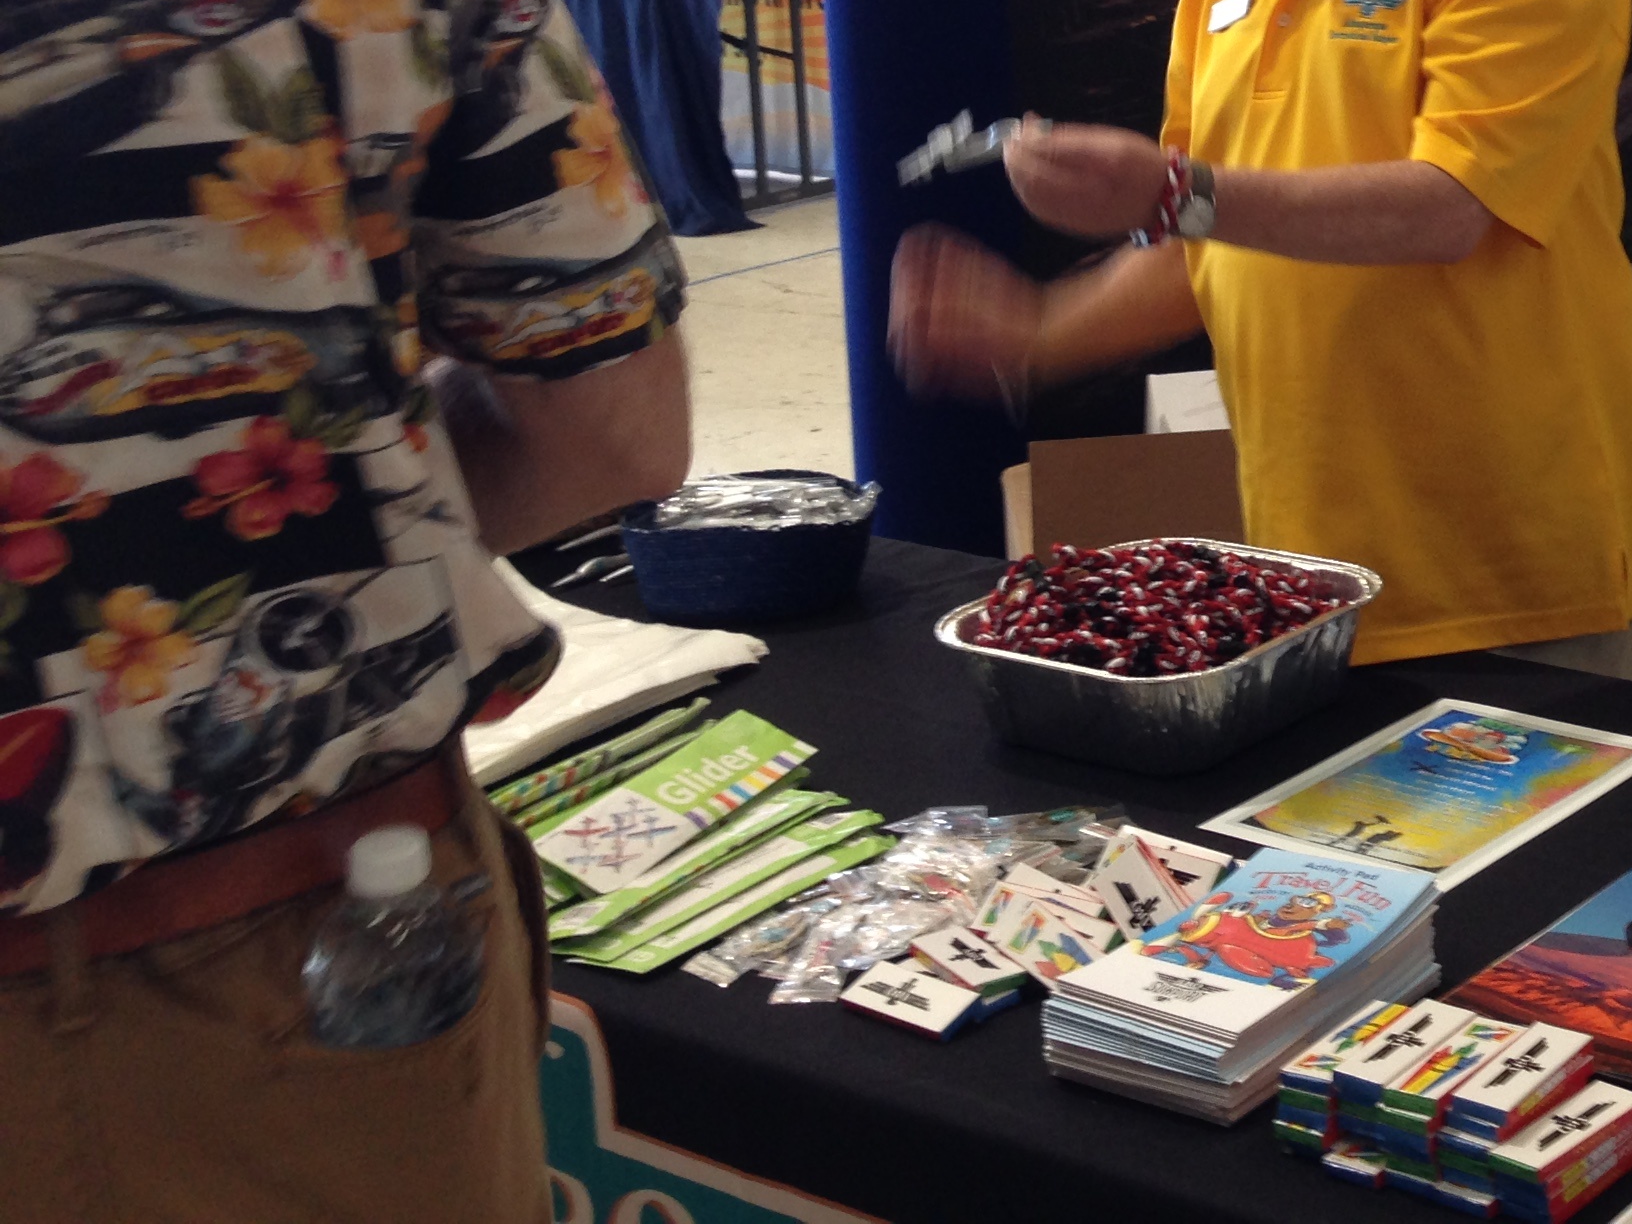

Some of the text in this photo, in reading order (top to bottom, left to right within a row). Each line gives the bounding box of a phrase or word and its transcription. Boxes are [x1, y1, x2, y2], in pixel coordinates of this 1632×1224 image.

[656, 744, 760, 806] Glider
[1252, 870, 1393, 911] Travel Fun
